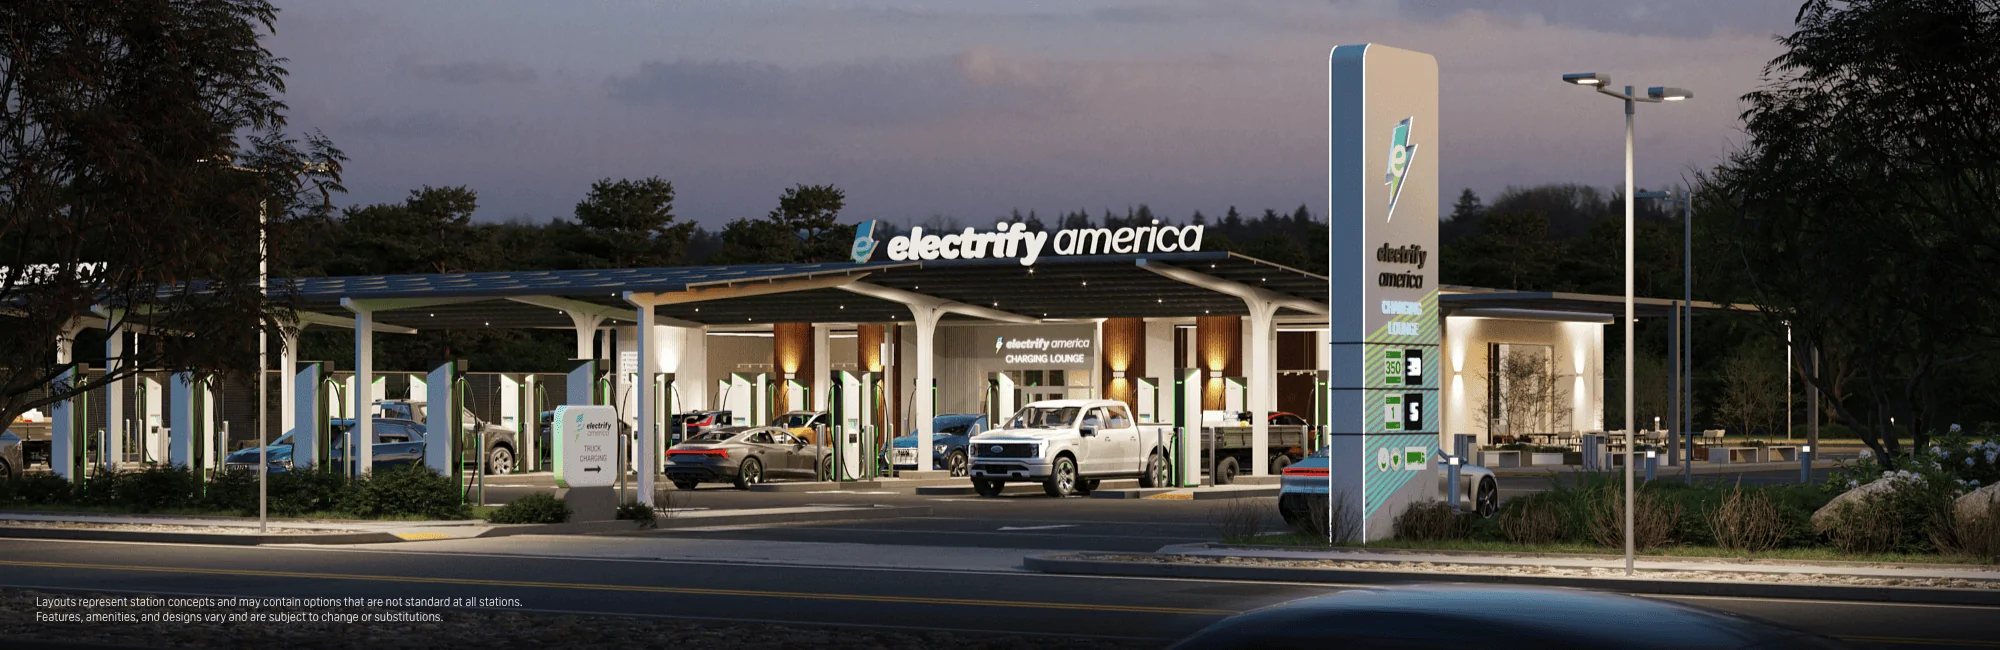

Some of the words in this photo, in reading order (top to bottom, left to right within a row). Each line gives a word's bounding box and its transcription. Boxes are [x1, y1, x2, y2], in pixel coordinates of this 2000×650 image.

[887, 222, 1048, 266] electrify
[1053, 219, 1205, 255] america
[1377, 243, 1427, 269] electrify
[1379, 270, 1423, 289] america
[1005, 337, 1051, 352] electrify
[1051, 338, 1091, 349] america
[1005, 354, 1048, 364] CHARGING
[1050, 354, 1085, 363] LOUNGE
[1386, 361, 1401, 374] 350
[586, 422, 612, 431] electrify
[579, 454, 608, 462] CHARGING
